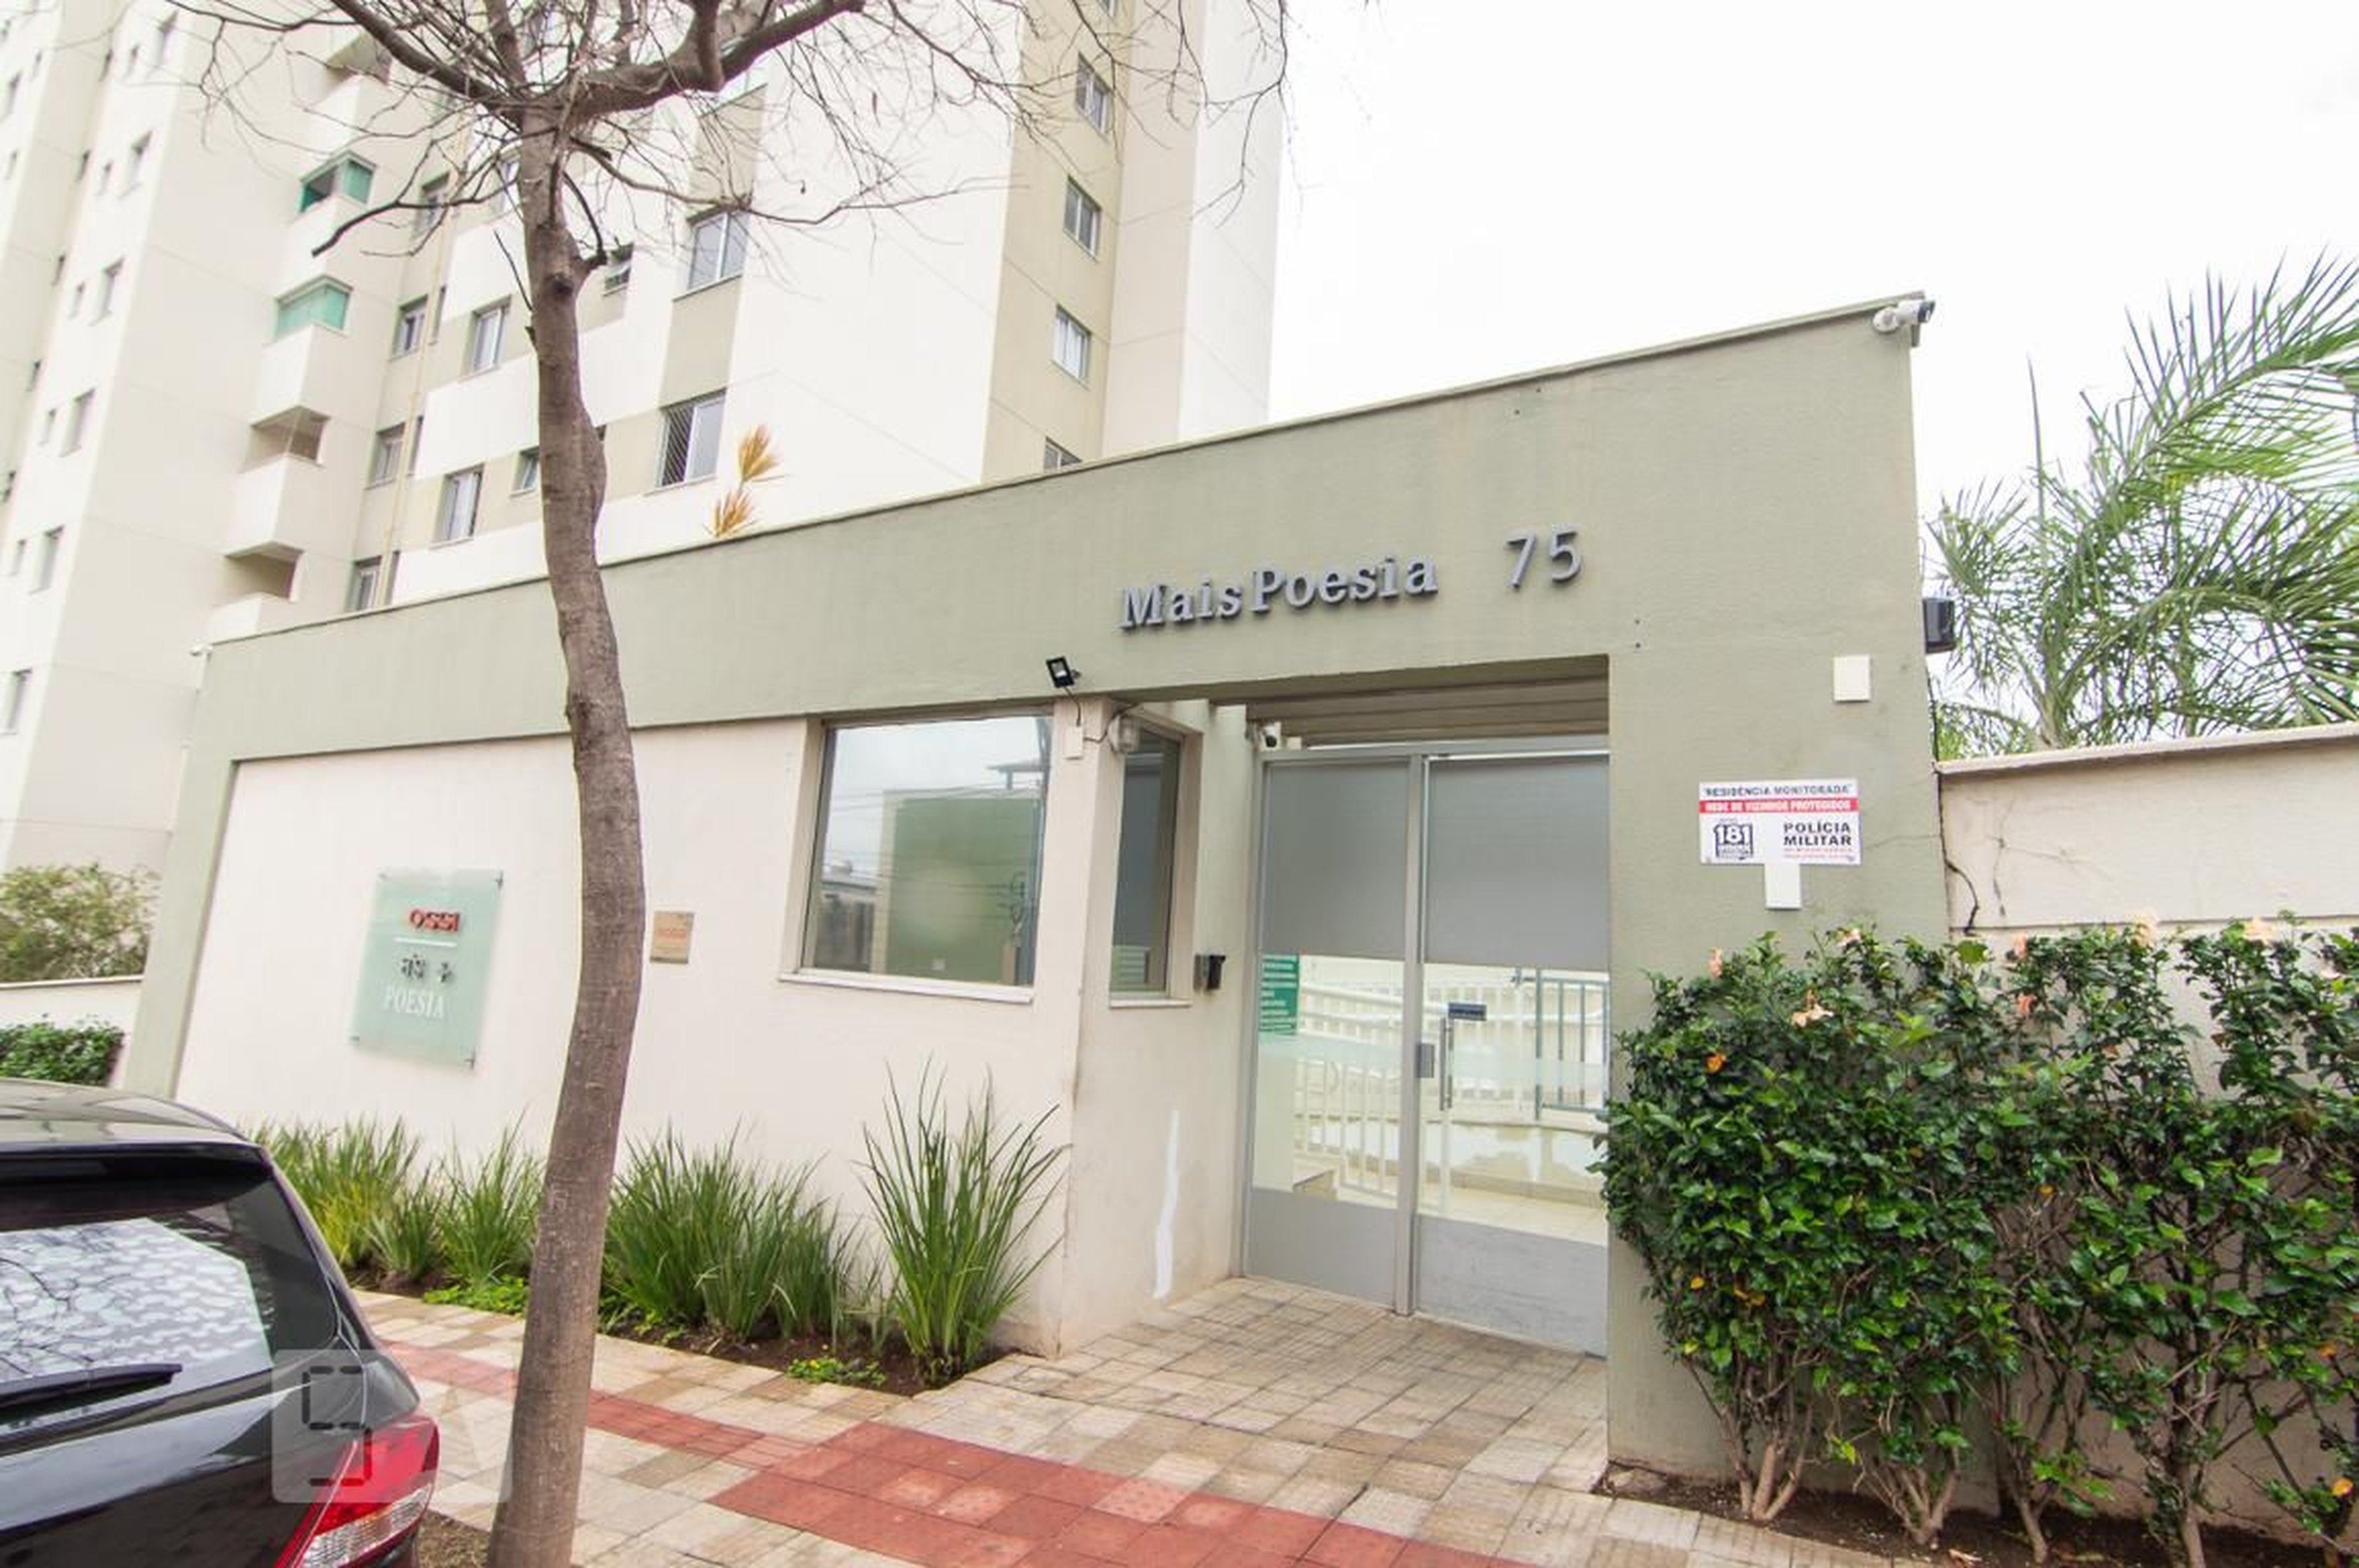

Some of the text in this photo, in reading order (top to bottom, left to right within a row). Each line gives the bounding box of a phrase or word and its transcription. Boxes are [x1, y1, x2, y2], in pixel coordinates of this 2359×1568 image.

[1505, 526, 1585, 591] 75
[1714, 824, 1752, 844] 181
[1783, 821, 1851, 833] POLÍCIA
[1783, 835, 1852, 846] MILITAR
[383, 984, 445, 1019] POESIA
